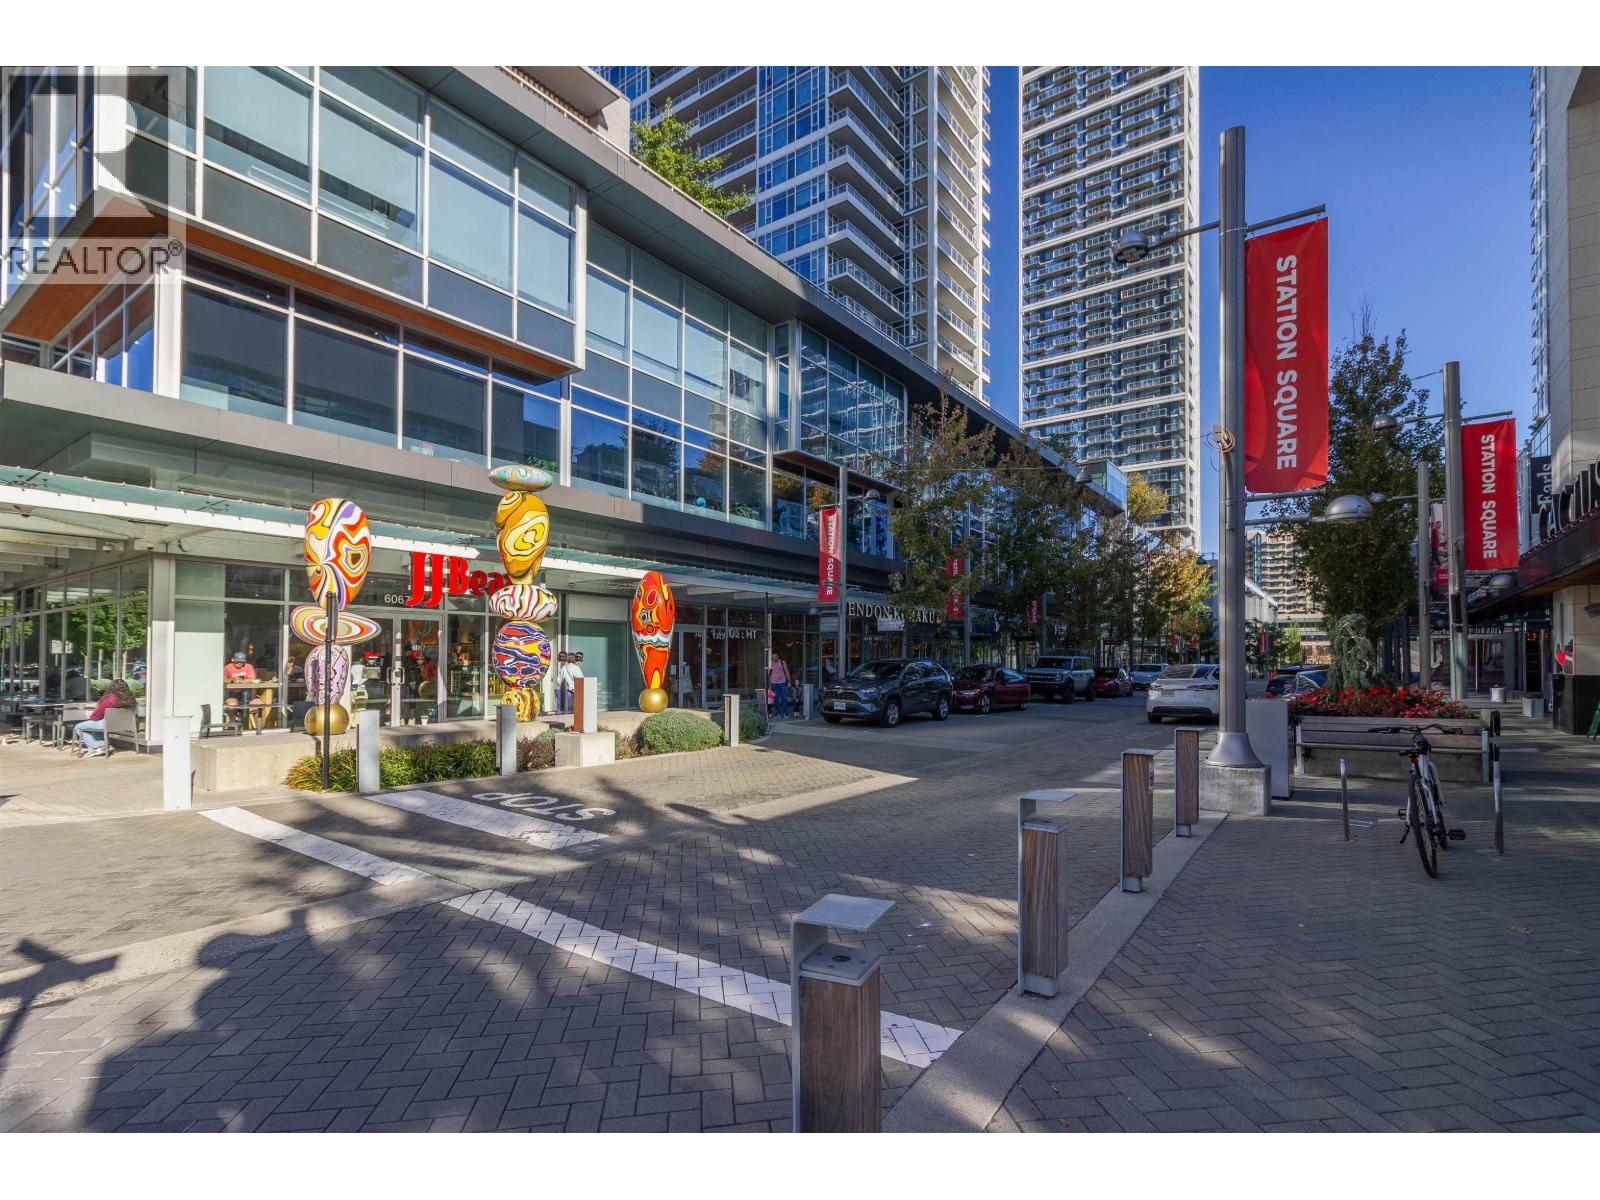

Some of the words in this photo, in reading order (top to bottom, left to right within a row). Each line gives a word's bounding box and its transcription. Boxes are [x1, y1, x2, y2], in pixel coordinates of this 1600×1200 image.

[1276, 254, 1298, 360] STATION
[1273, 370, 1298, 470] SQUARE
[1480, 434, 1496, 494] STATION
[1479, 500, 1497, 559] SQUARE
[848, 602, 891, 619] ENDON
[893, 607, 936, 624] KAKU
[472, 792, 616, 821] STOP
